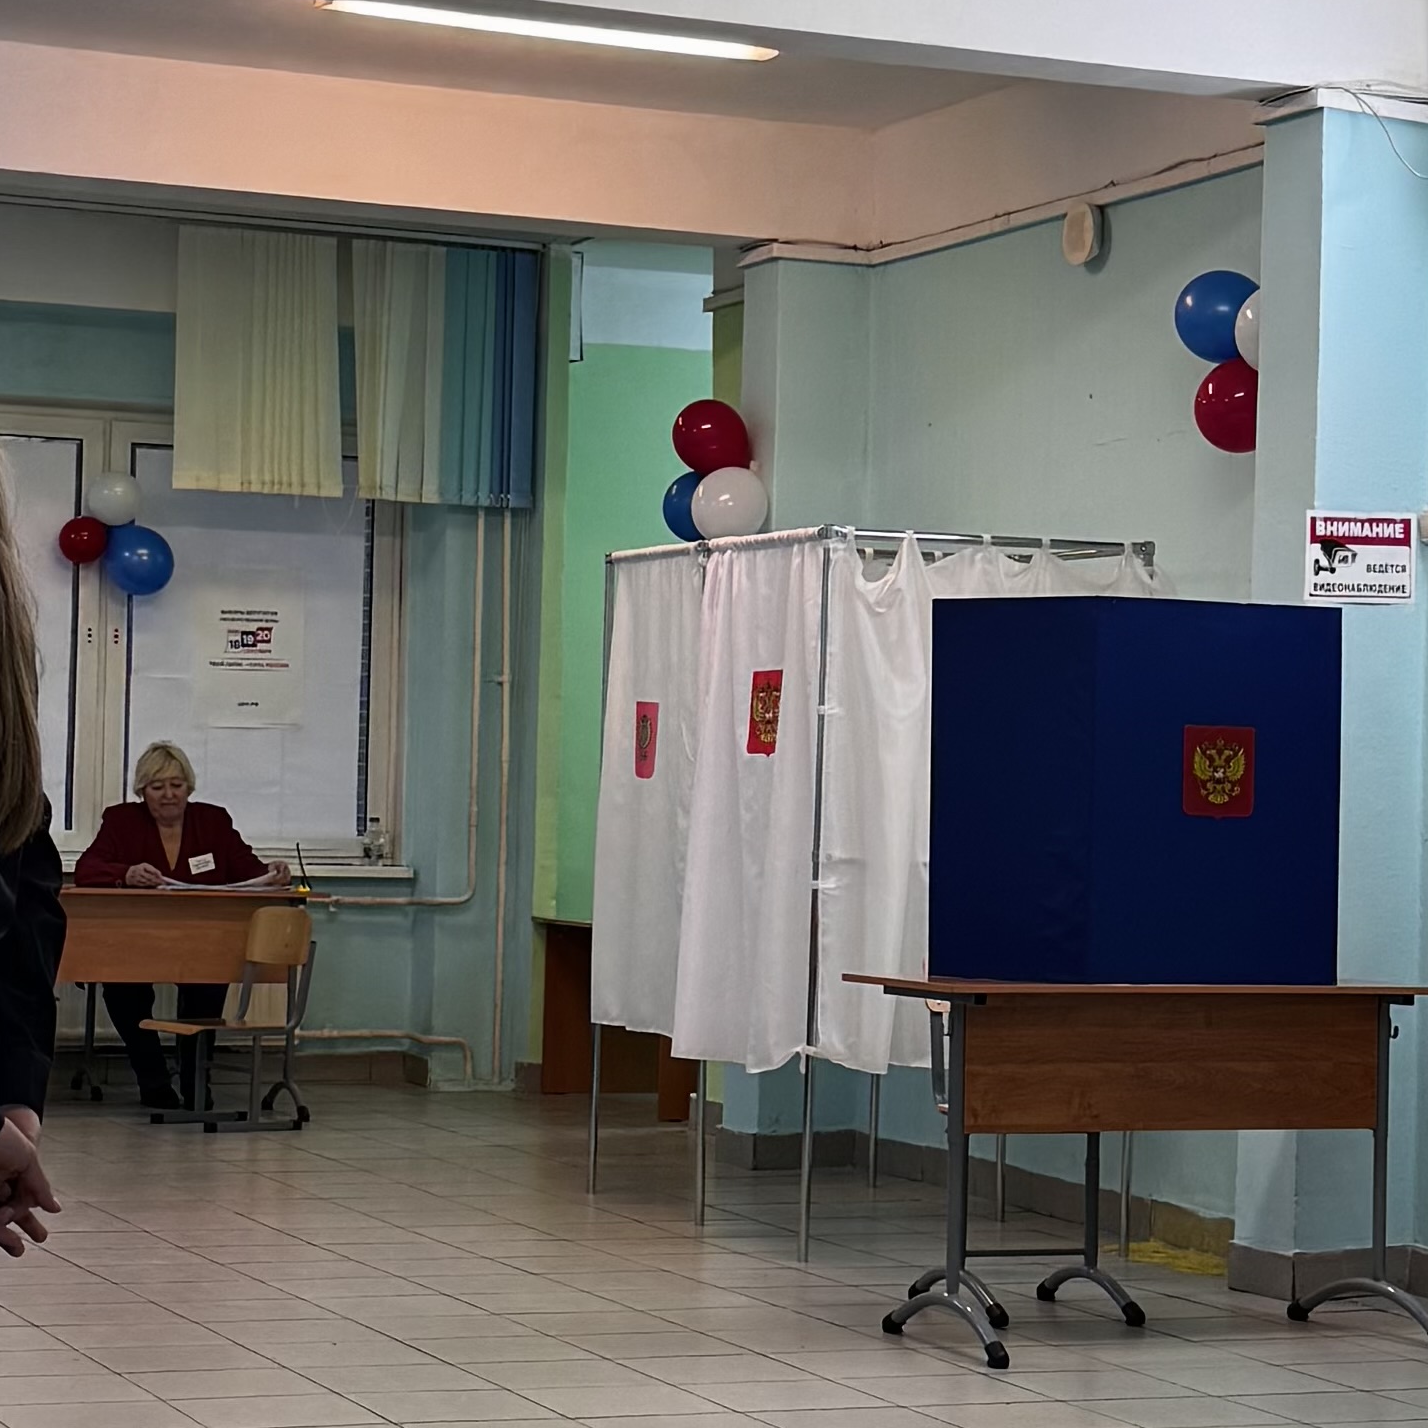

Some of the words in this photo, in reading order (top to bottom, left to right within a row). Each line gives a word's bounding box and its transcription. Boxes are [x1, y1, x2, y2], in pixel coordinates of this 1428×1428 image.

[1315, 520, 1405, 539] ВНИМАНИЕ
[1313, 582, 1407, 594] ВИДЕОНАБЛЮДЕНИЕ
[229, 639, 241, 650] 18
[242, 634, 254, 645] 19
[256, 631, 271, 640] 20
